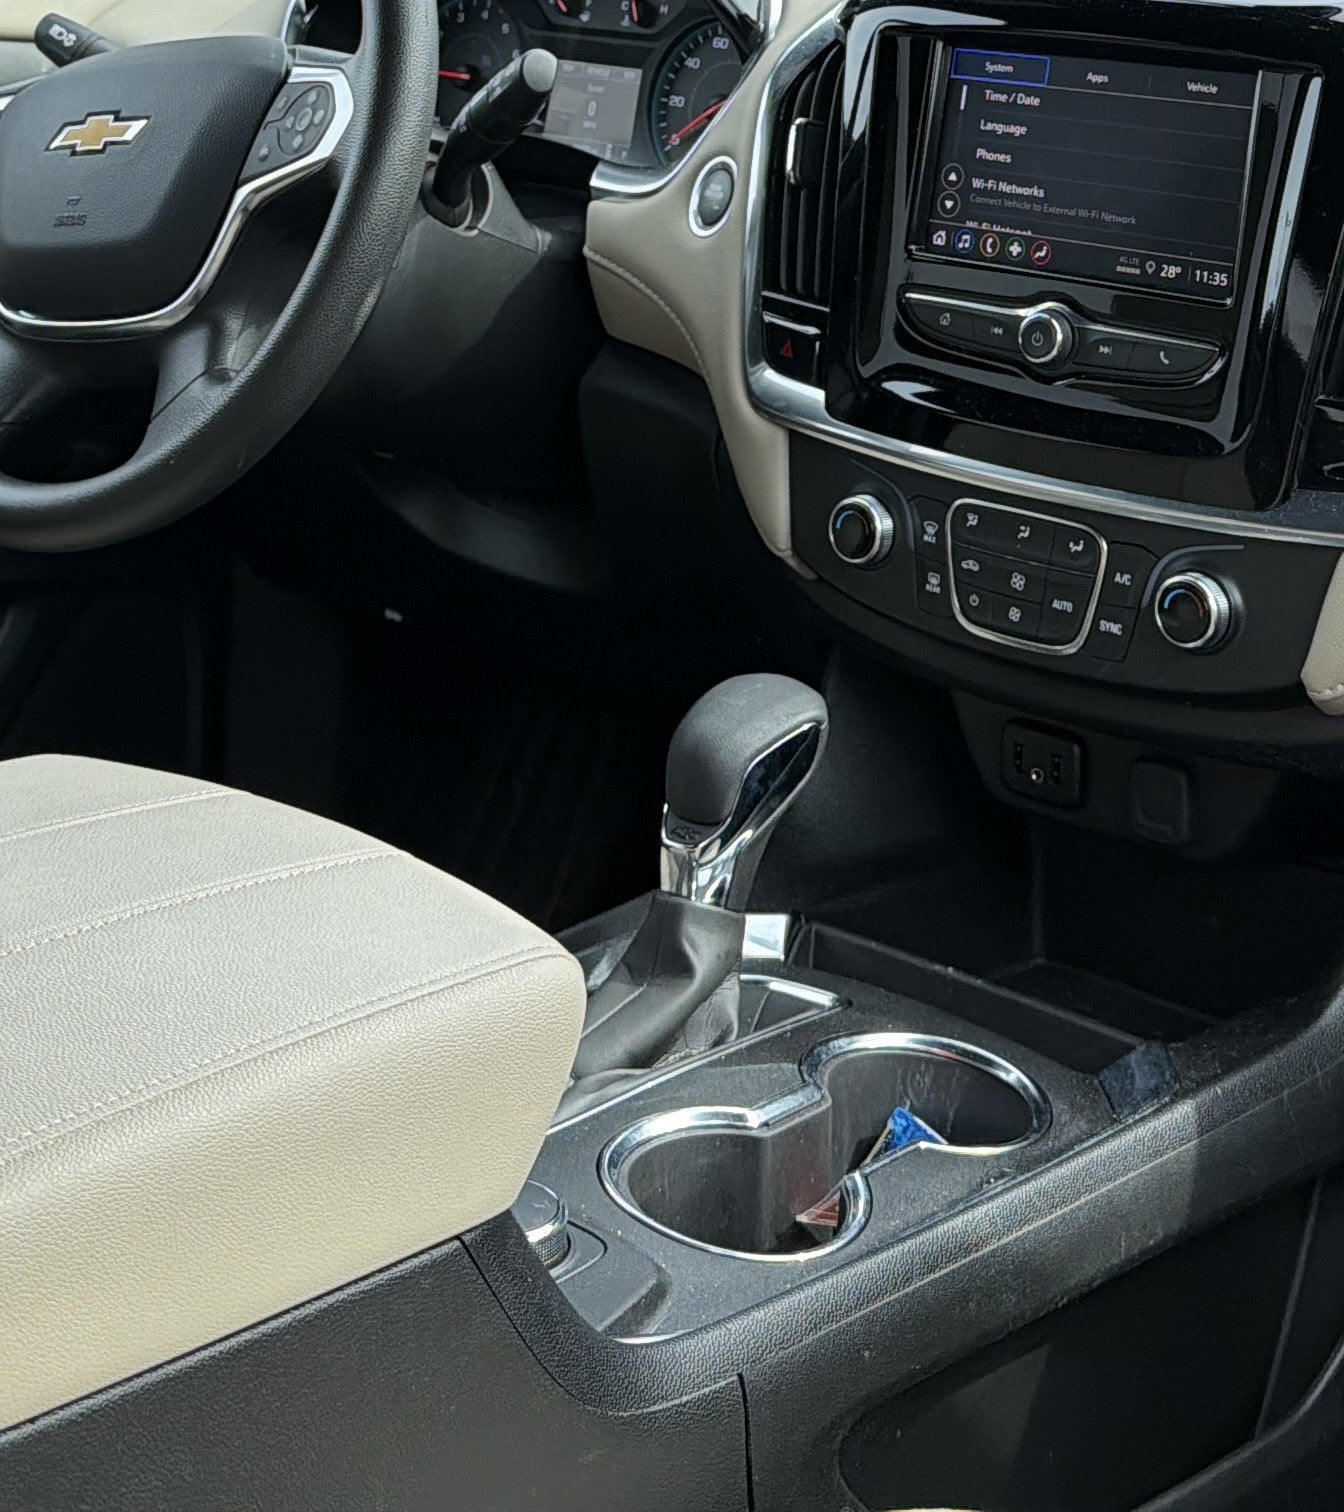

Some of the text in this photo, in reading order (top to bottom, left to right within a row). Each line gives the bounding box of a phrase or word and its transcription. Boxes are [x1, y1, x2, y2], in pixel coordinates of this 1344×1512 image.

[660, 4, 669, 14] H
[712, 37, 729, 50] 60
[684, 57, 700, 69] 40
[985, 61, 1013, 75] System
[1086, 71, 1109, 85] Apps
[1187, 81, 1218, 95] Vehicle
[669, 95, 685, 108] 20
[984, 90, 1008, 104] Time
[1017, 94, 1041, 107] Date
[980, 120, 1027, 137] Language
[976, 148, 1012, 164] Phones
[972, 177, 1045, 198] Wi-Fi Networks
[969, 194, 1137, 225] Connect Vehicle to External Wi-Fi Network
[1160, 264, 1182, 279] 28°
[1195, 270, 1229, 287] 11:35
[1114, 572, 1131, 586] A/C
[1052, 598, 1073, 614] AUTO
[1099, 619, 1123, 636] SYNC
